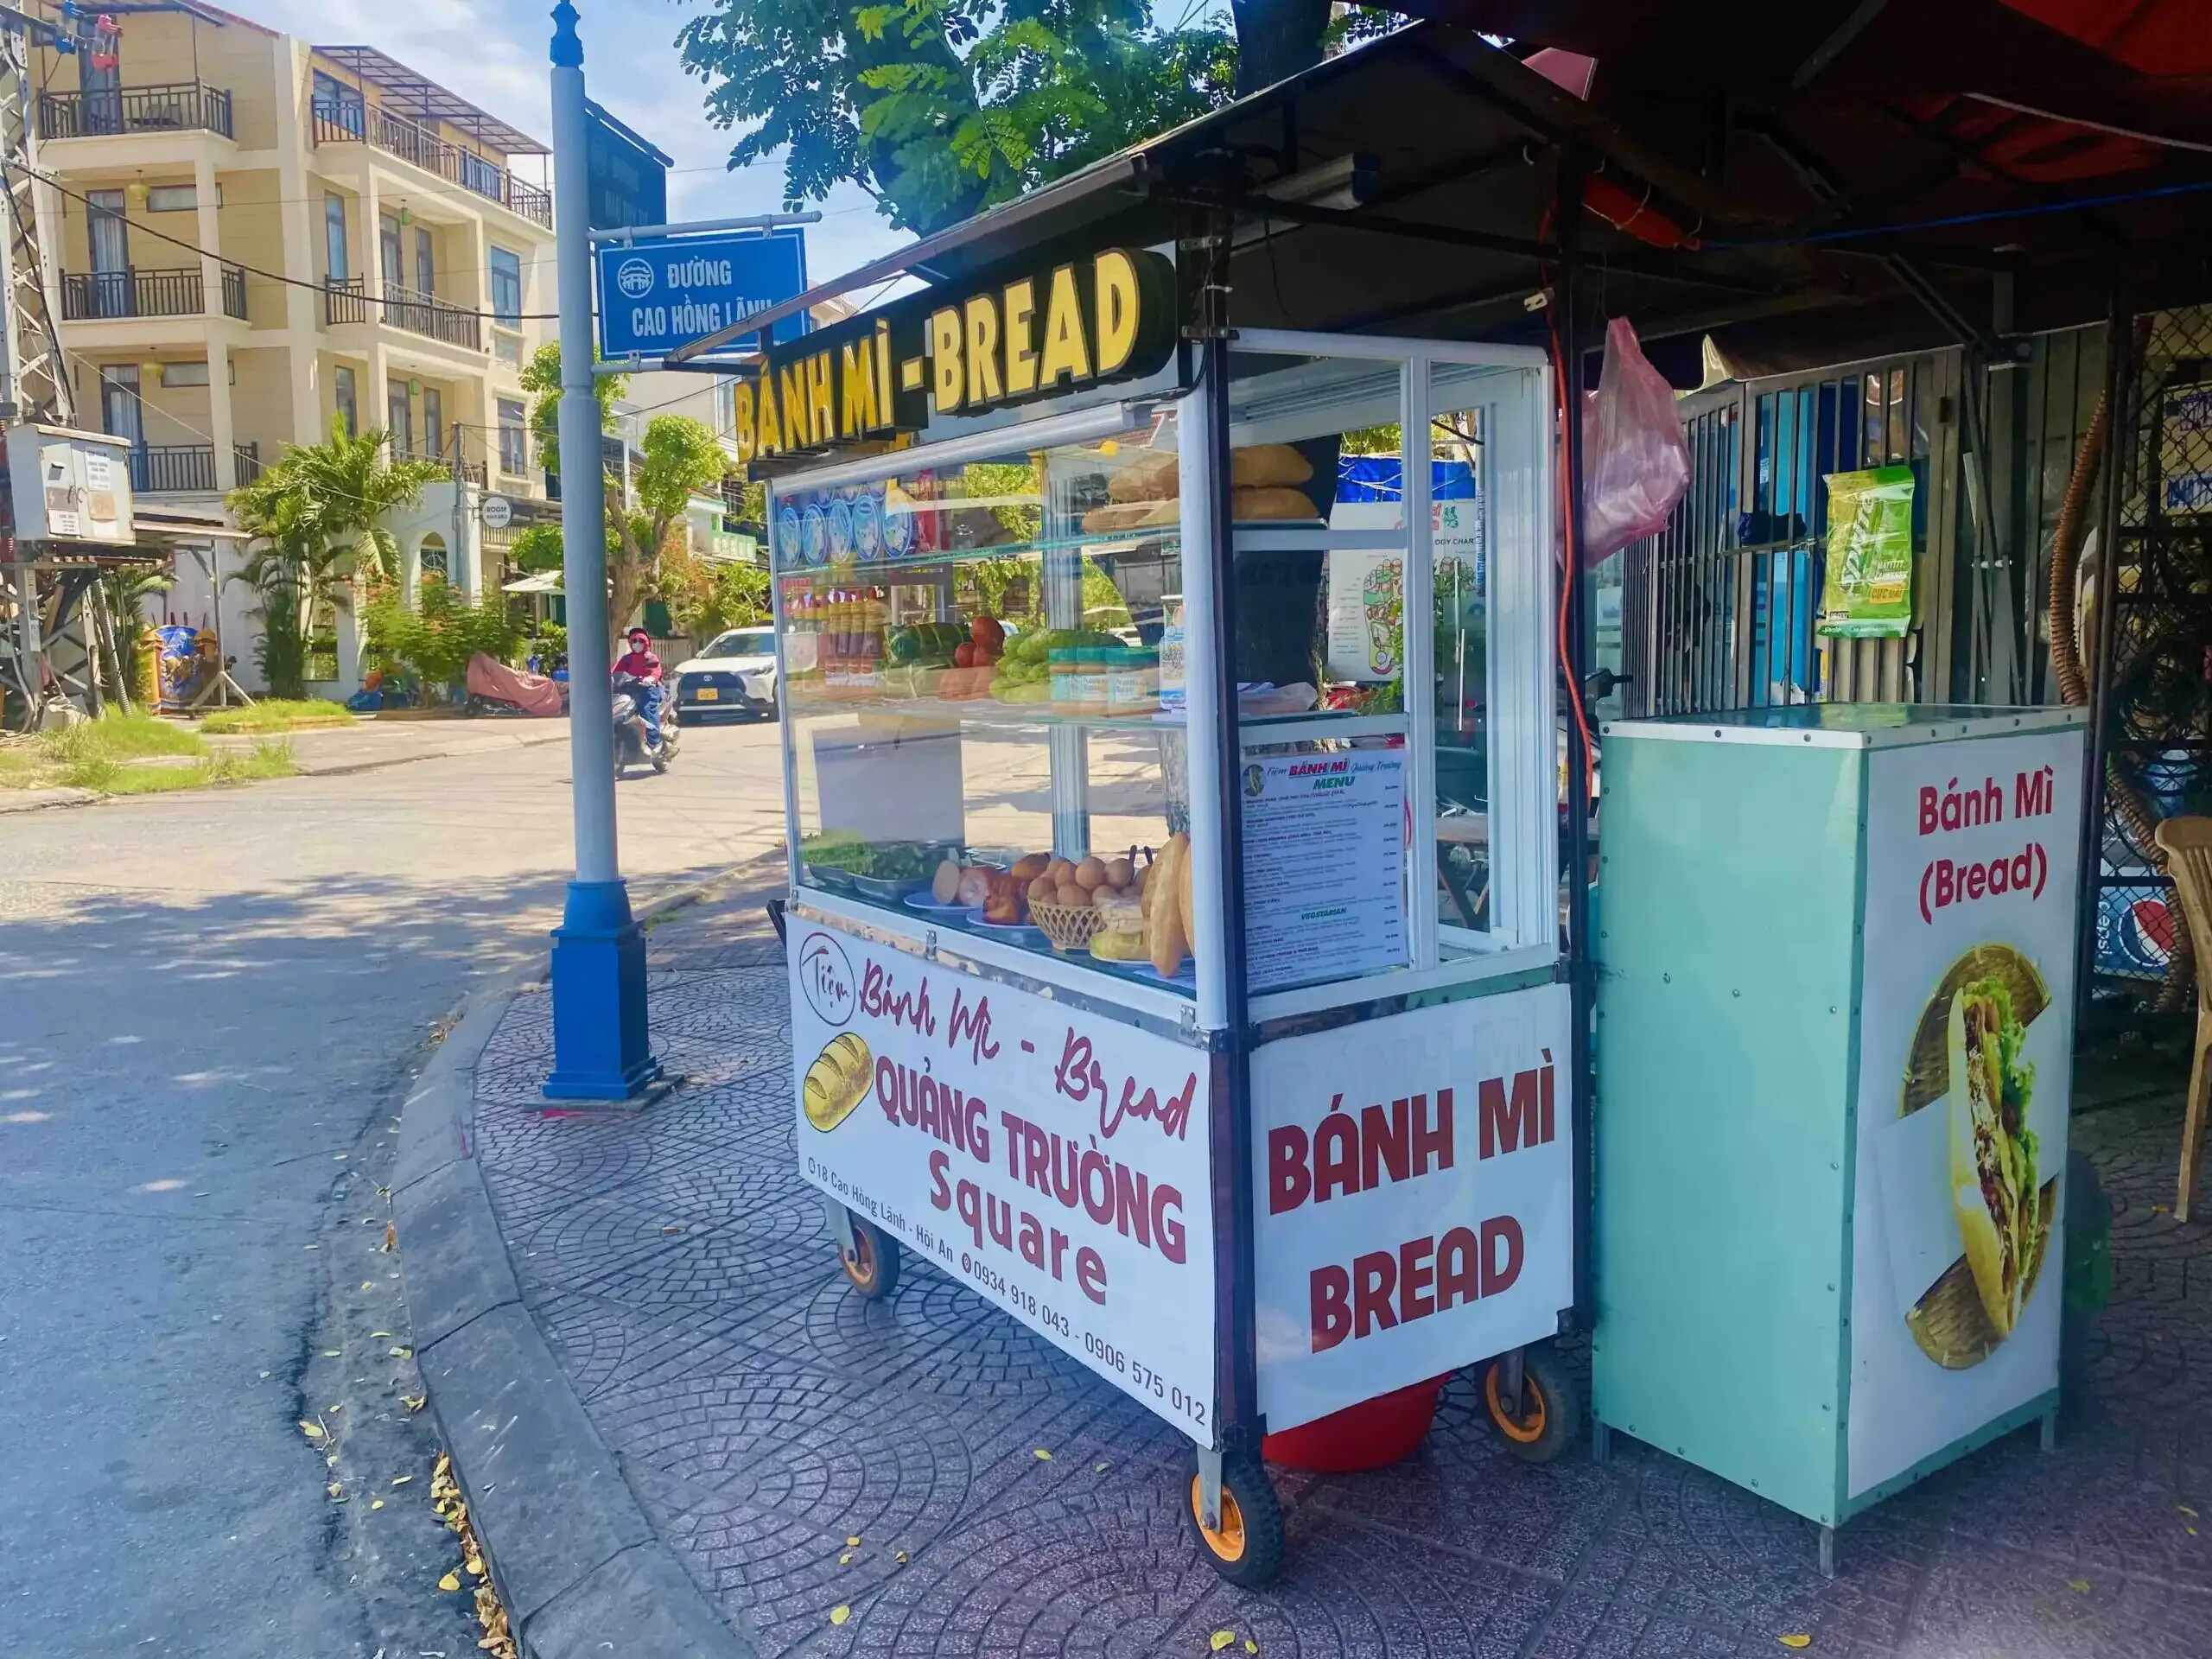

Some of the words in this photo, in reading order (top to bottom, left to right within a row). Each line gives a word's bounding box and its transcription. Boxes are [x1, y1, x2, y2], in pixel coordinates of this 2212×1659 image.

[632, 308, 666, 337] CAO
[671, 294, 721, 334] HỒNG
[667, 256, 732, 289] ĐƯỜNG
[734, 355, 835, 464] BÁNH
[842, 317, 893, 441] MÌ
[931, 247, 1141, 414] BREAD
[1313, 776, 1355, 790] MENU
[1919, 777, 2003, 836] Bánh
[2015, 764, 2054, 819] Mì
[1919, 842, 2047, 925] (Bread)
[802, 945, 850, 1008] Tiệm
[859, 957, 936, 1037] Bánh
[949, 988, 1000, 1065] Mì
[1055, 1027, 1196, 1141] Bread
[876, 1056, 990, 1164] QUẢNG
[1001, 1110, 1186, 1264] TRƯỜNG
[1268, 1093, 1454, 1216] BÁNH
[1478, 1047, 1555, 1160] MÌ
[817, 1163, 828, 1182] 18
[831, 1173, 849, 1196] Cao
[917, 1224, 934, 1251] Hội
[938, 1238, 953, 1262] An
[974, 1261, 1006, 1296] 0934
[1011, 1284, 1037, 1317] 918
[1042, 1305, 1070, 1338] 043
[1085, 1332, 1125, 1373] 0906
[1132, 1360, 1164, 1398] 575
[1172, 1386, 1205, 1426] 012
[930, 1149, 1108, 1306] Square
[1310, 1215, 1524, 1354] BREAD
